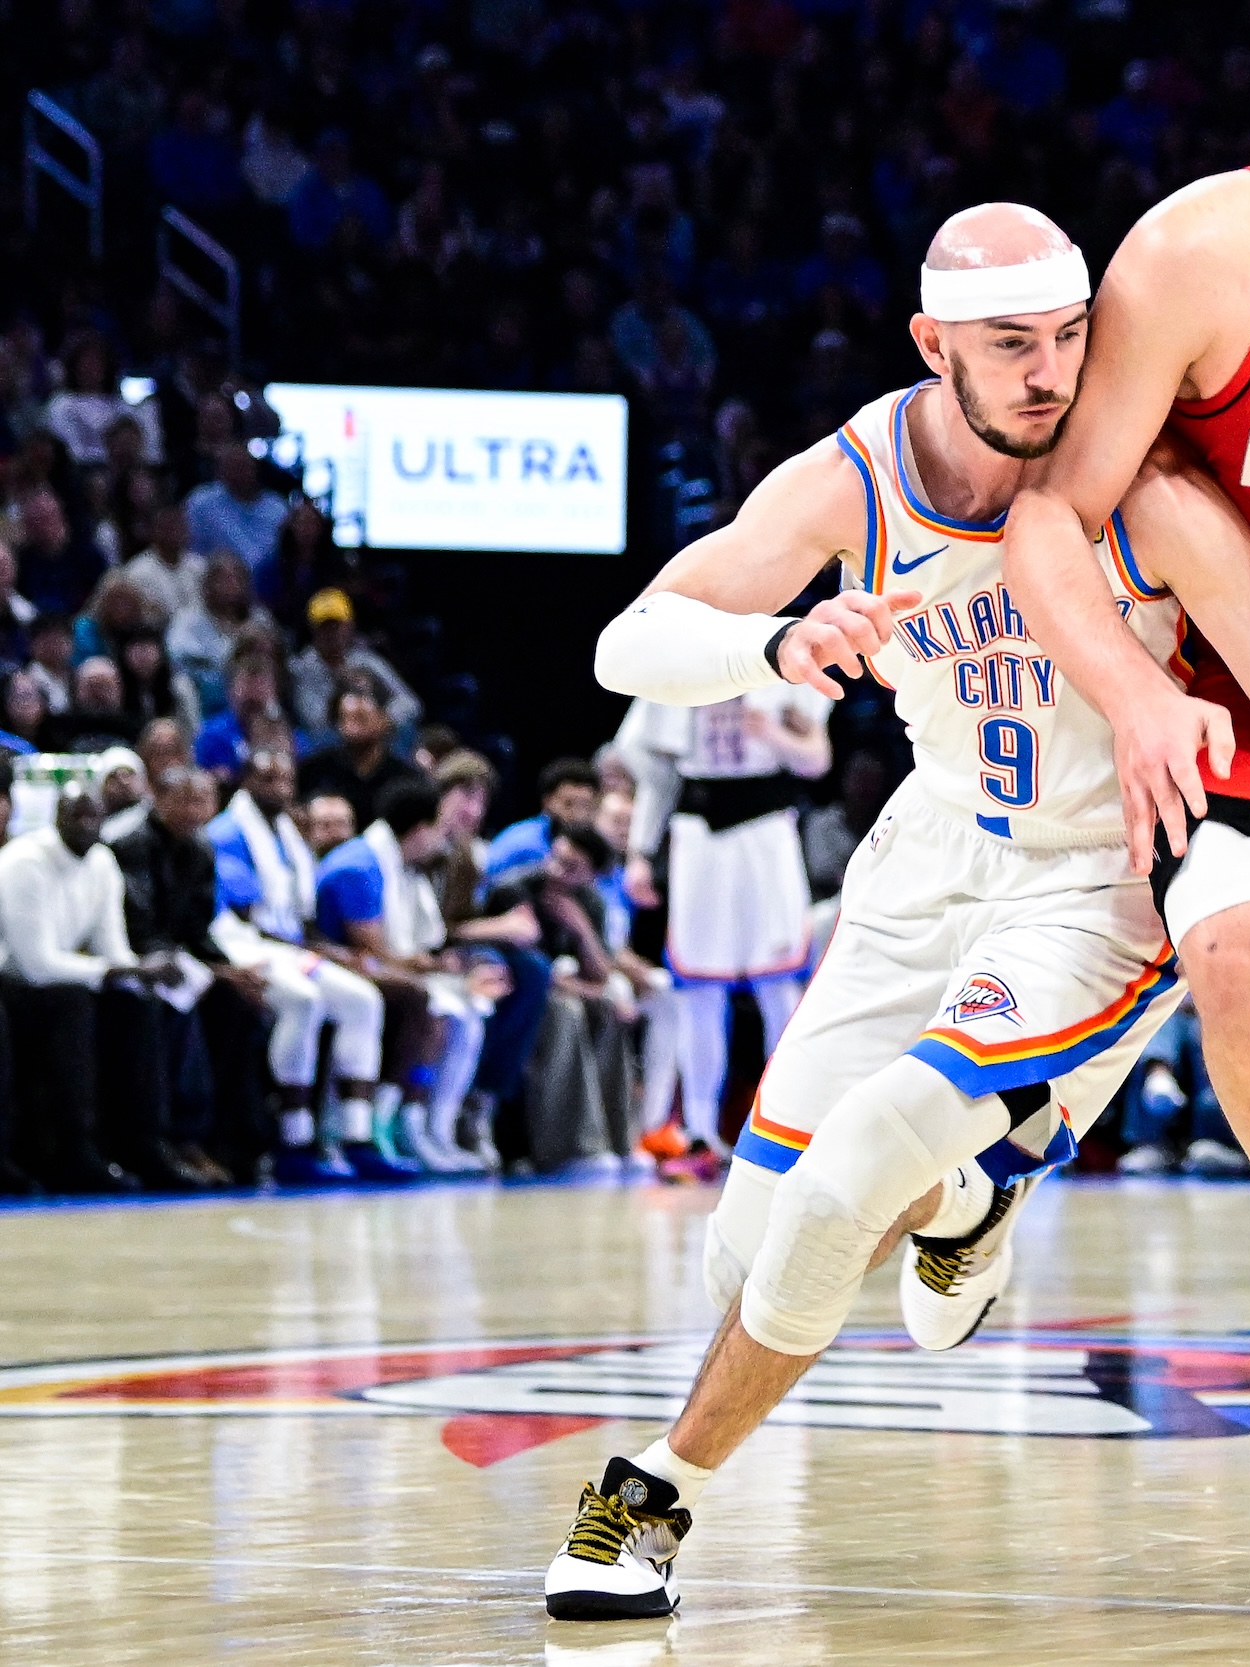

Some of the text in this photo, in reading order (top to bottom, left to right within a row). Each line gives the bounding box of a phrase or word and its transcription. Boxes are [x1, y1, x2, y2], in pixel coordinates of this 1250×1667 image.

[391, 437, 604, 484] ULTRA
[954, 651, 1056, 710] CITY
[978, 714, 1040, 810] 9
